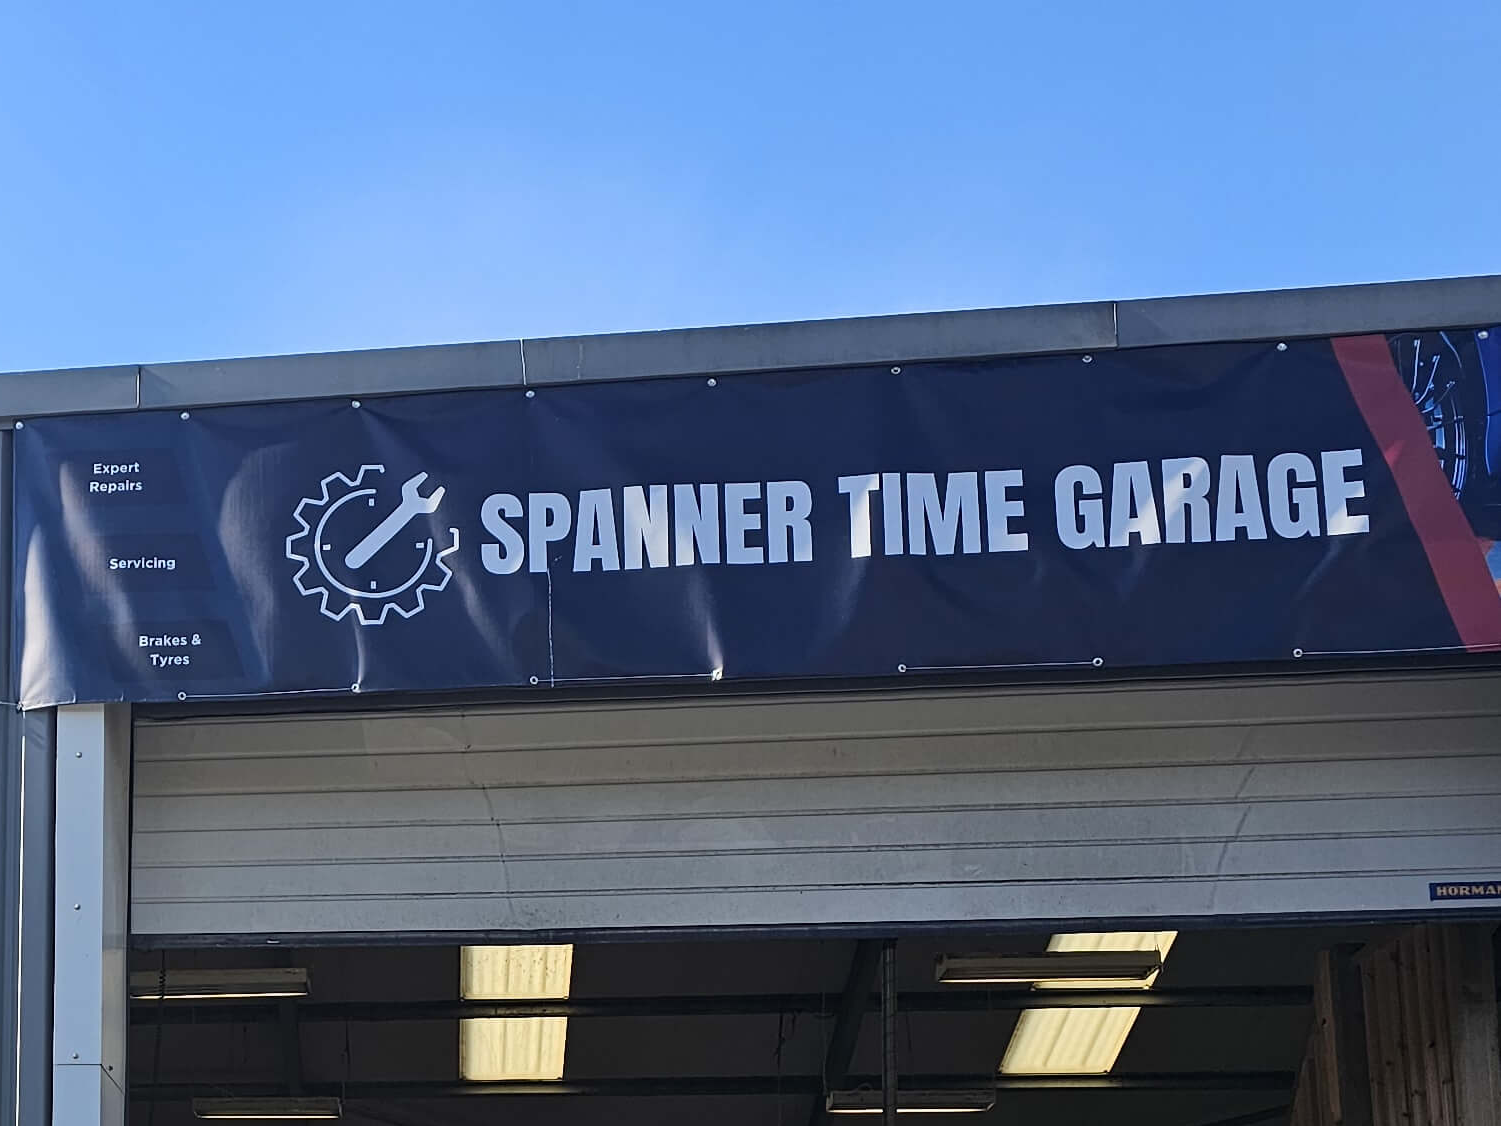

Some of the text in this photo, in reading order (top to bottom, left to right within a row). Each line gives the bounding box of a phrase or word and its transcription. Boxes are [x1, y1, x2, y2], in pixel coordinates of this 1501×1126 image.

[93, 462, 140, 475] Expert
[89, 480, 143, 494] Repairs
[481, 448, 1370, 575] SPANNER TIME GARAGE
[109, 557, 176, 570] Servicing
[138, 634, 202, 647] Brakes &
[150, 654, 190, 667] Tyres
